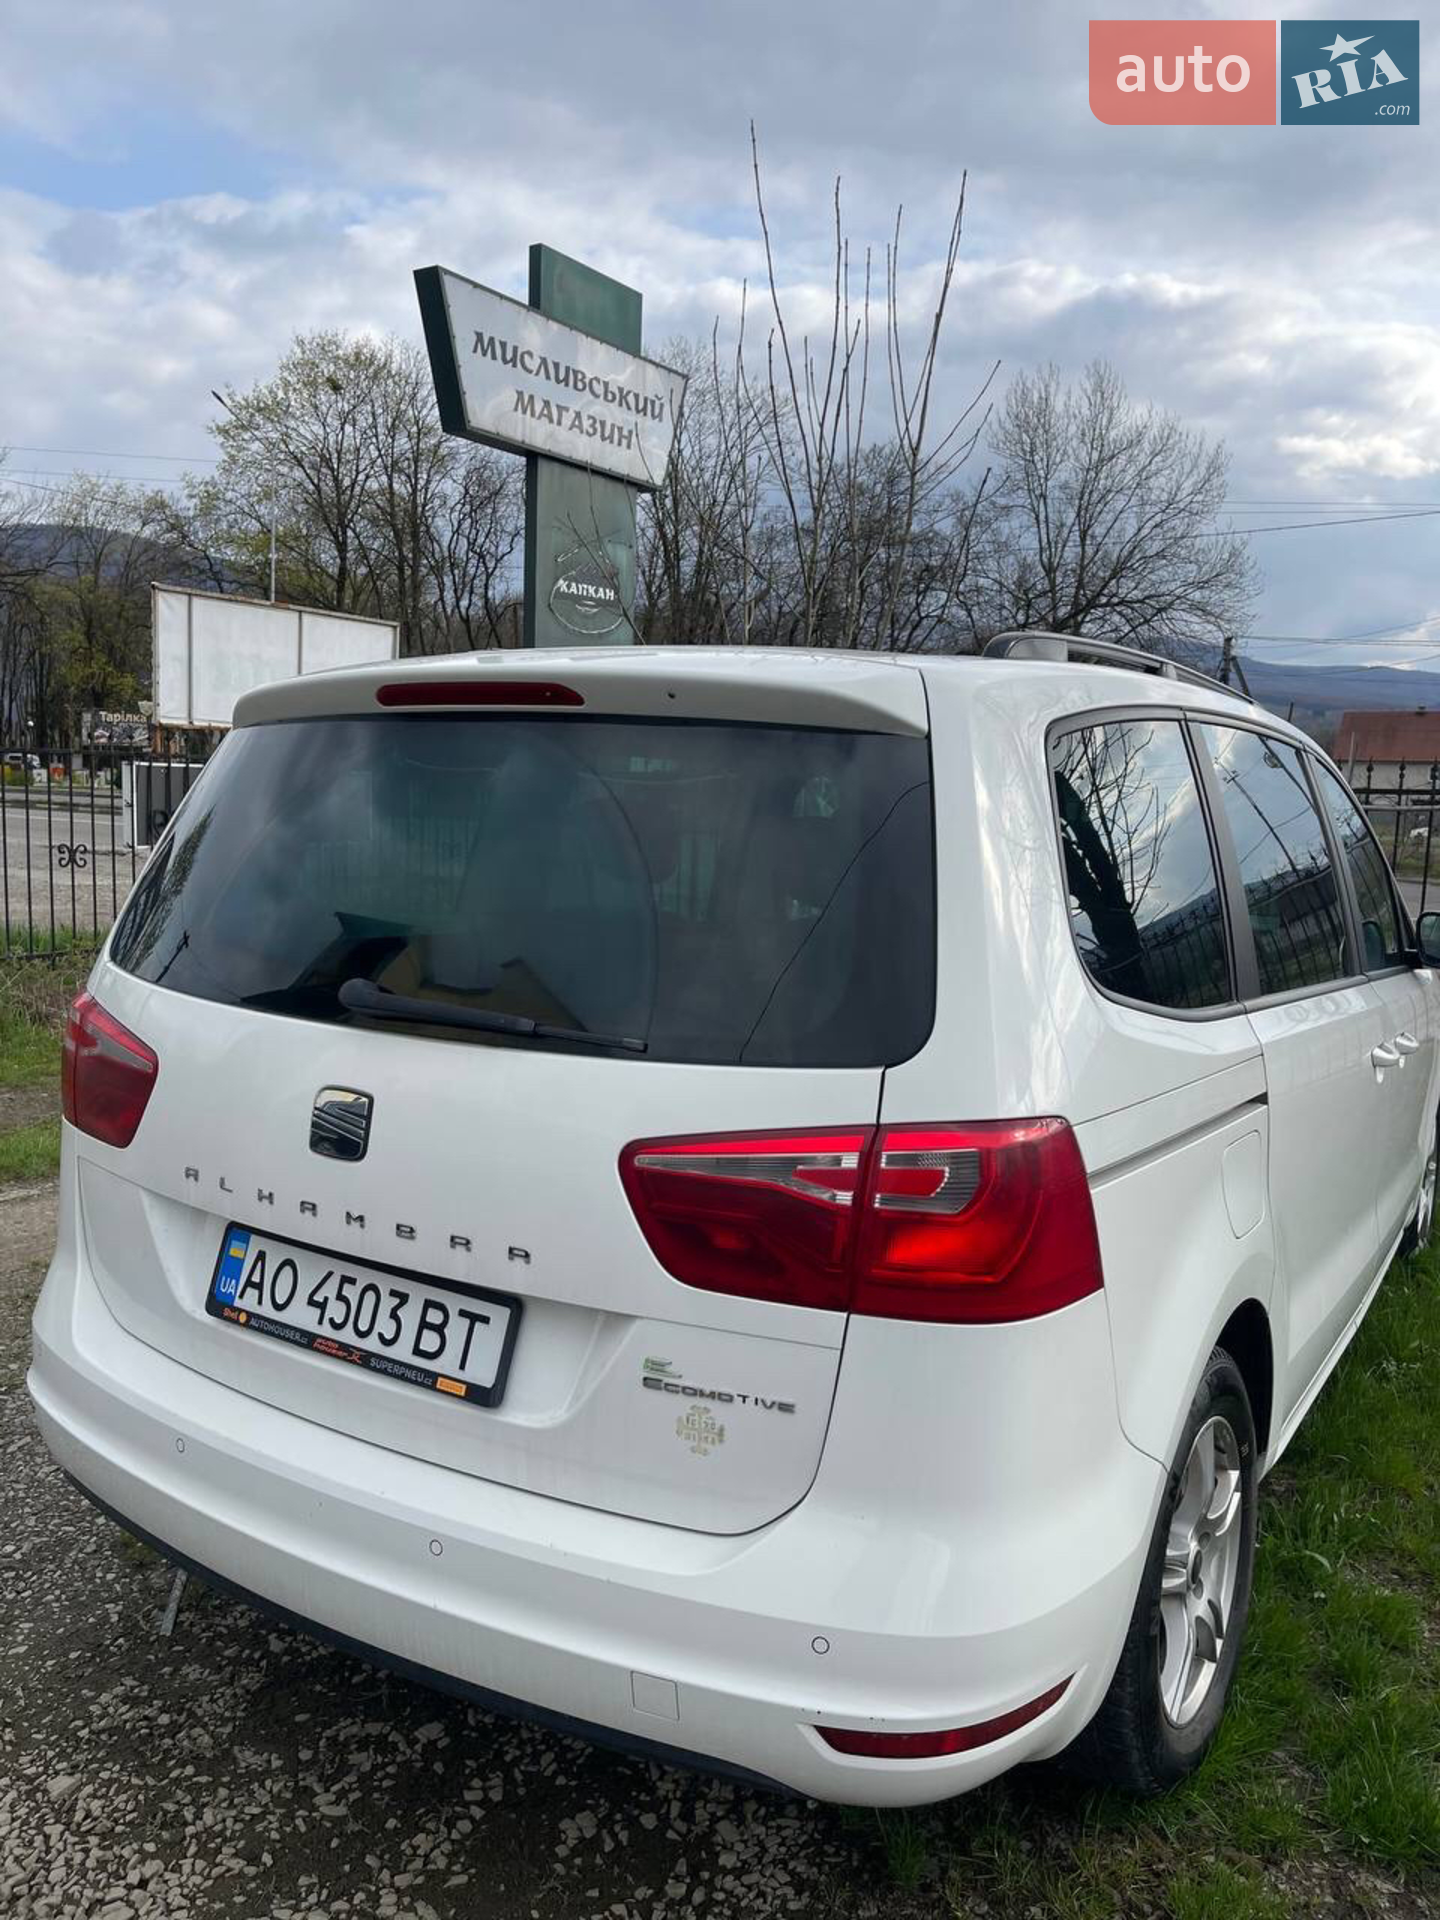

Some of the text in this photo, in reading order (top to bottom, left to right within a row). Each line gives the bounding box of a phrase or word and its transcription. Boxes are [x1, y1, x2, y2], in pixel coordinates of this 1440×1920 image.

[472, 330, 666, 423] МИСЛИВСЬКИЙ
[513, 389, 634, 451] МАГАЗИН
[560, 580, 615, 601] КАПКАН
[184, 1166, 532, 1265] ALHAMBRA
[220, 1275, 237, 1296] UA
[238, 1249, 491, 1371] AO 4503 BT
